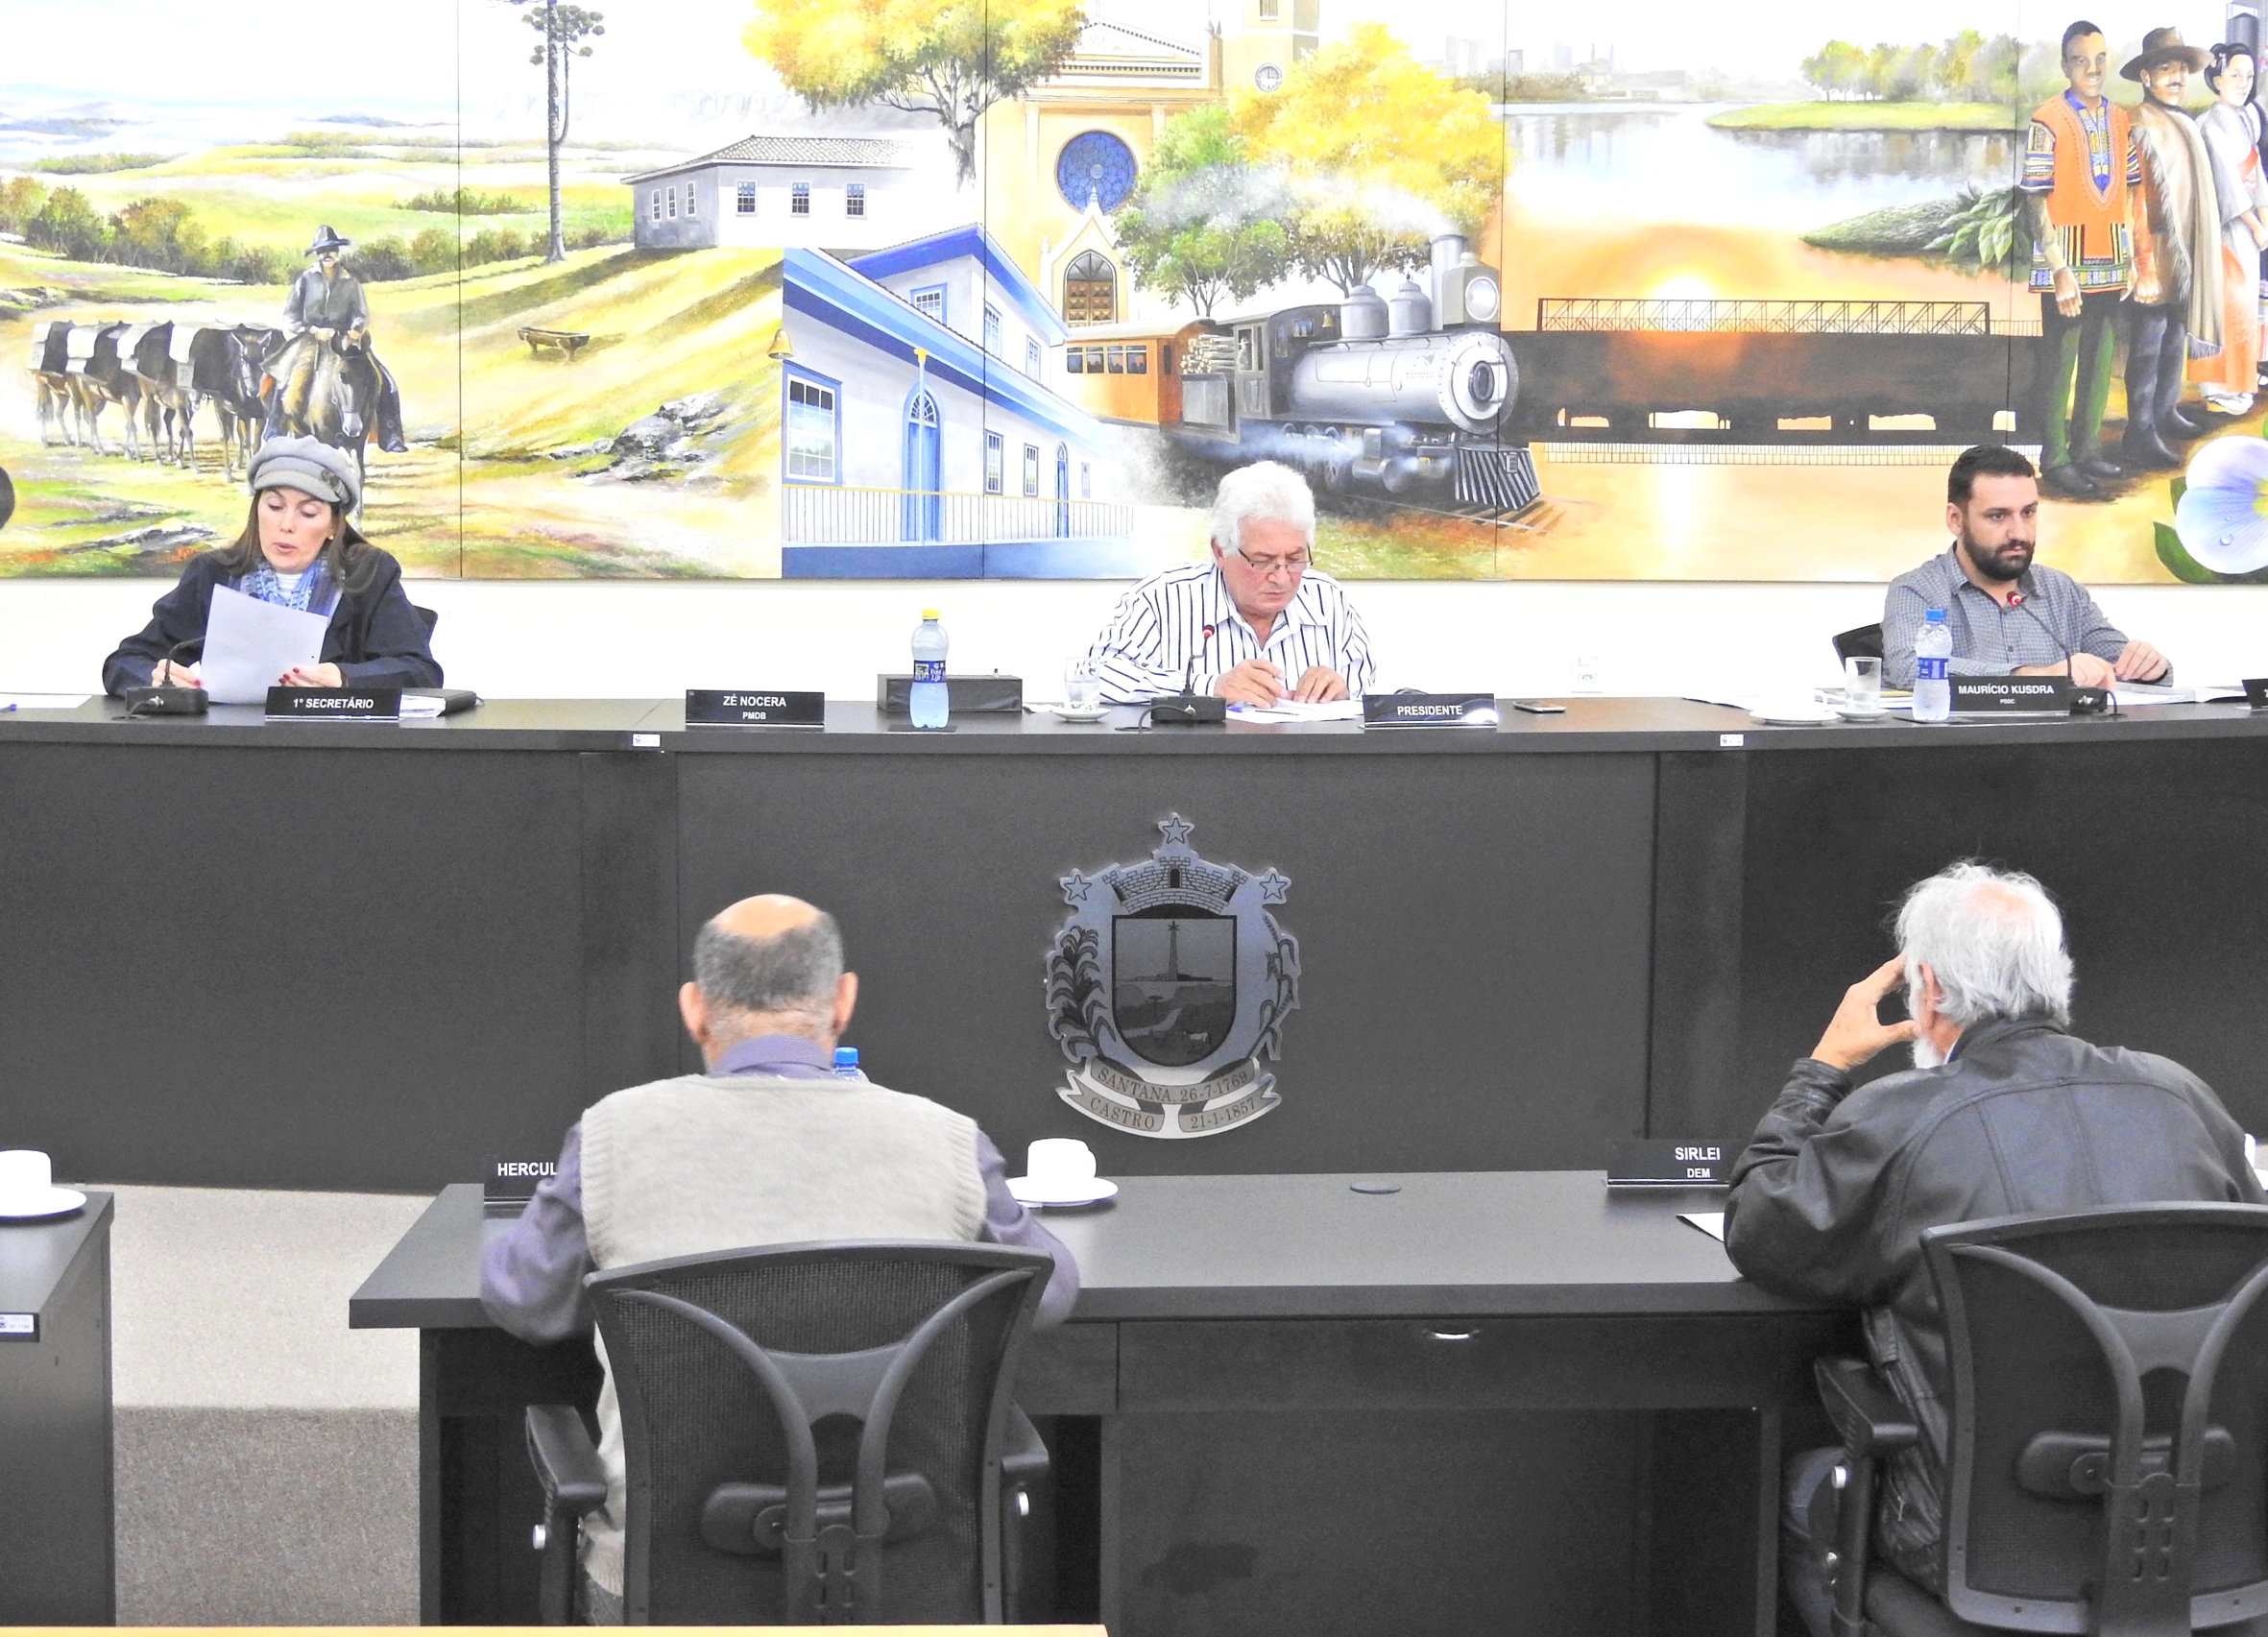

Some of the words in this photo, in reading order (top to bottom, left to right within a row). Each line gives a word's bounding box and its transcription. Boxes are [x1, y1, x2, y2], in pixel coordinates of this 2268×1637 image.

[1958, 684, 2010, 695] MAURÍCIO
[2011, 685, 2055, 694] KUSDRA
[305, 696, 374, 709] SECRETÁRIO
[722, 693, 738, 707] ZÉ
[739, 696, 786, 708] NOCERA
[742, 711, 767, 720] PMDB
[1397, 705, 1463, 716] PRESIDENTE
[1089, 1096, 1155, 1130] CASTRO
[1675, 1146, 1721, 1161] SIRLEI
[496, 1162, 558, 1177] HERCUL
[1686, 1168, 1711, 1179] DEM
